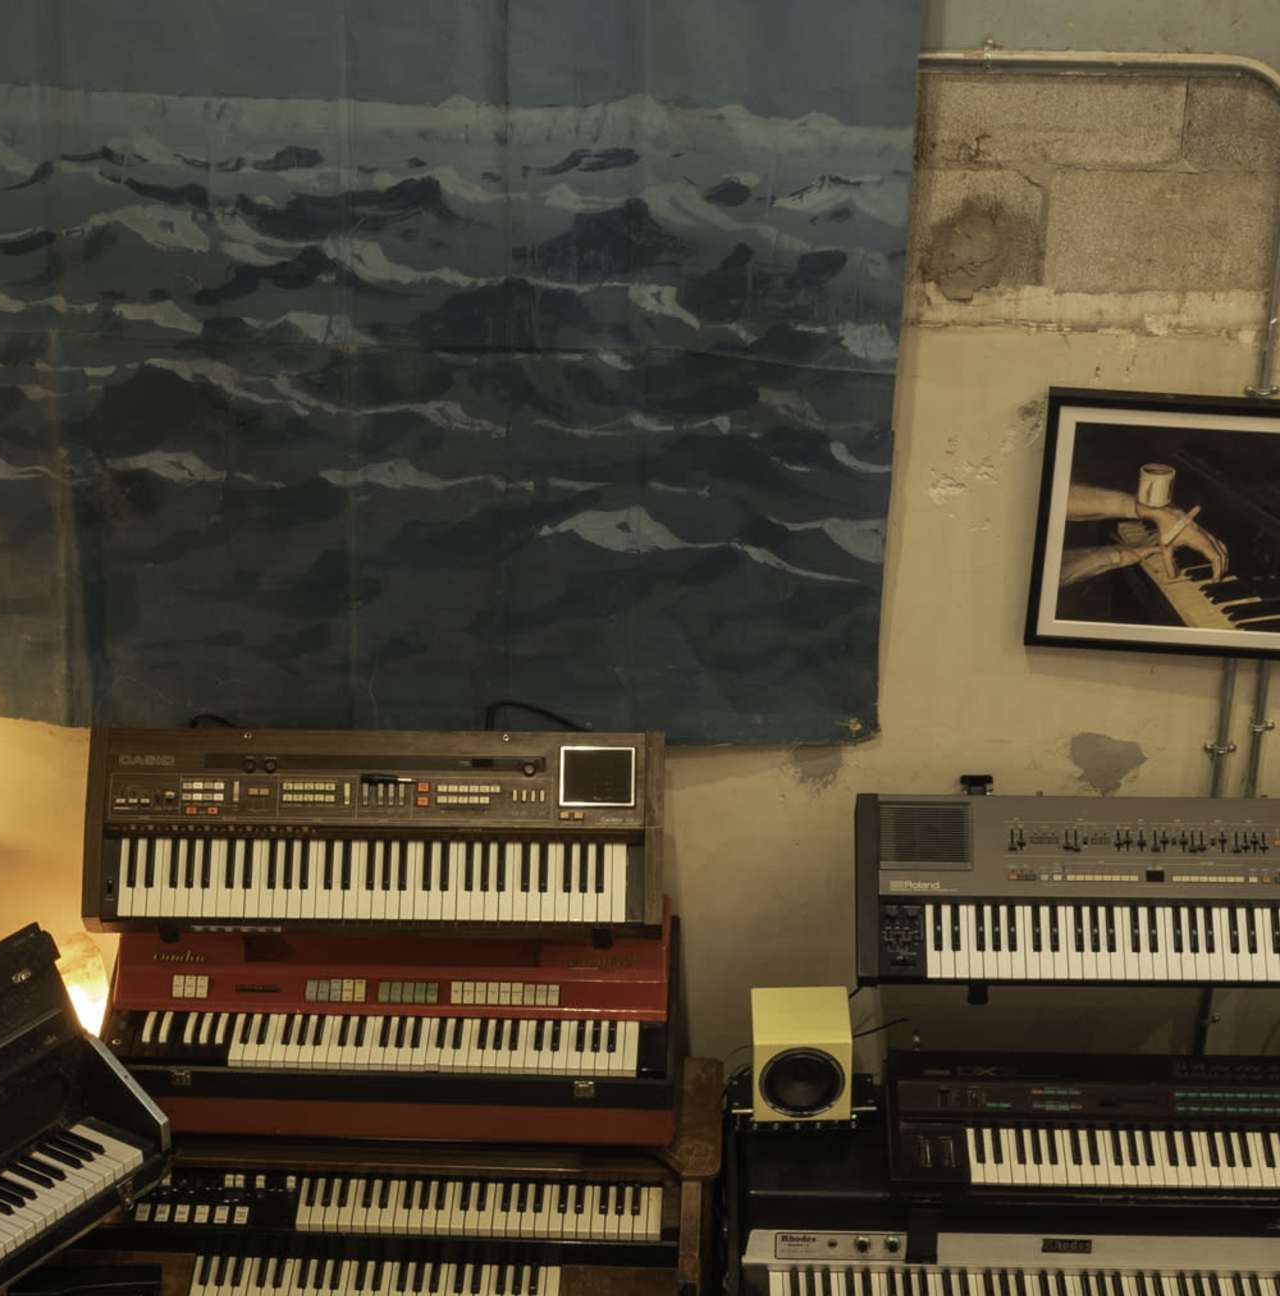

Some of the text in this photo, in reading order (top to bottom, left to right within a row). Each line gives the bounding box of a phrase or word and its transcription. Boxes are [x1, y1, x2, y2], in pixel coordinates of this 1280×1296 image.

[118, 754, 176, 766] CASIO
[904, 879, 941, 889] Roland
[780, 1234, 816, 1243] Rhodes
